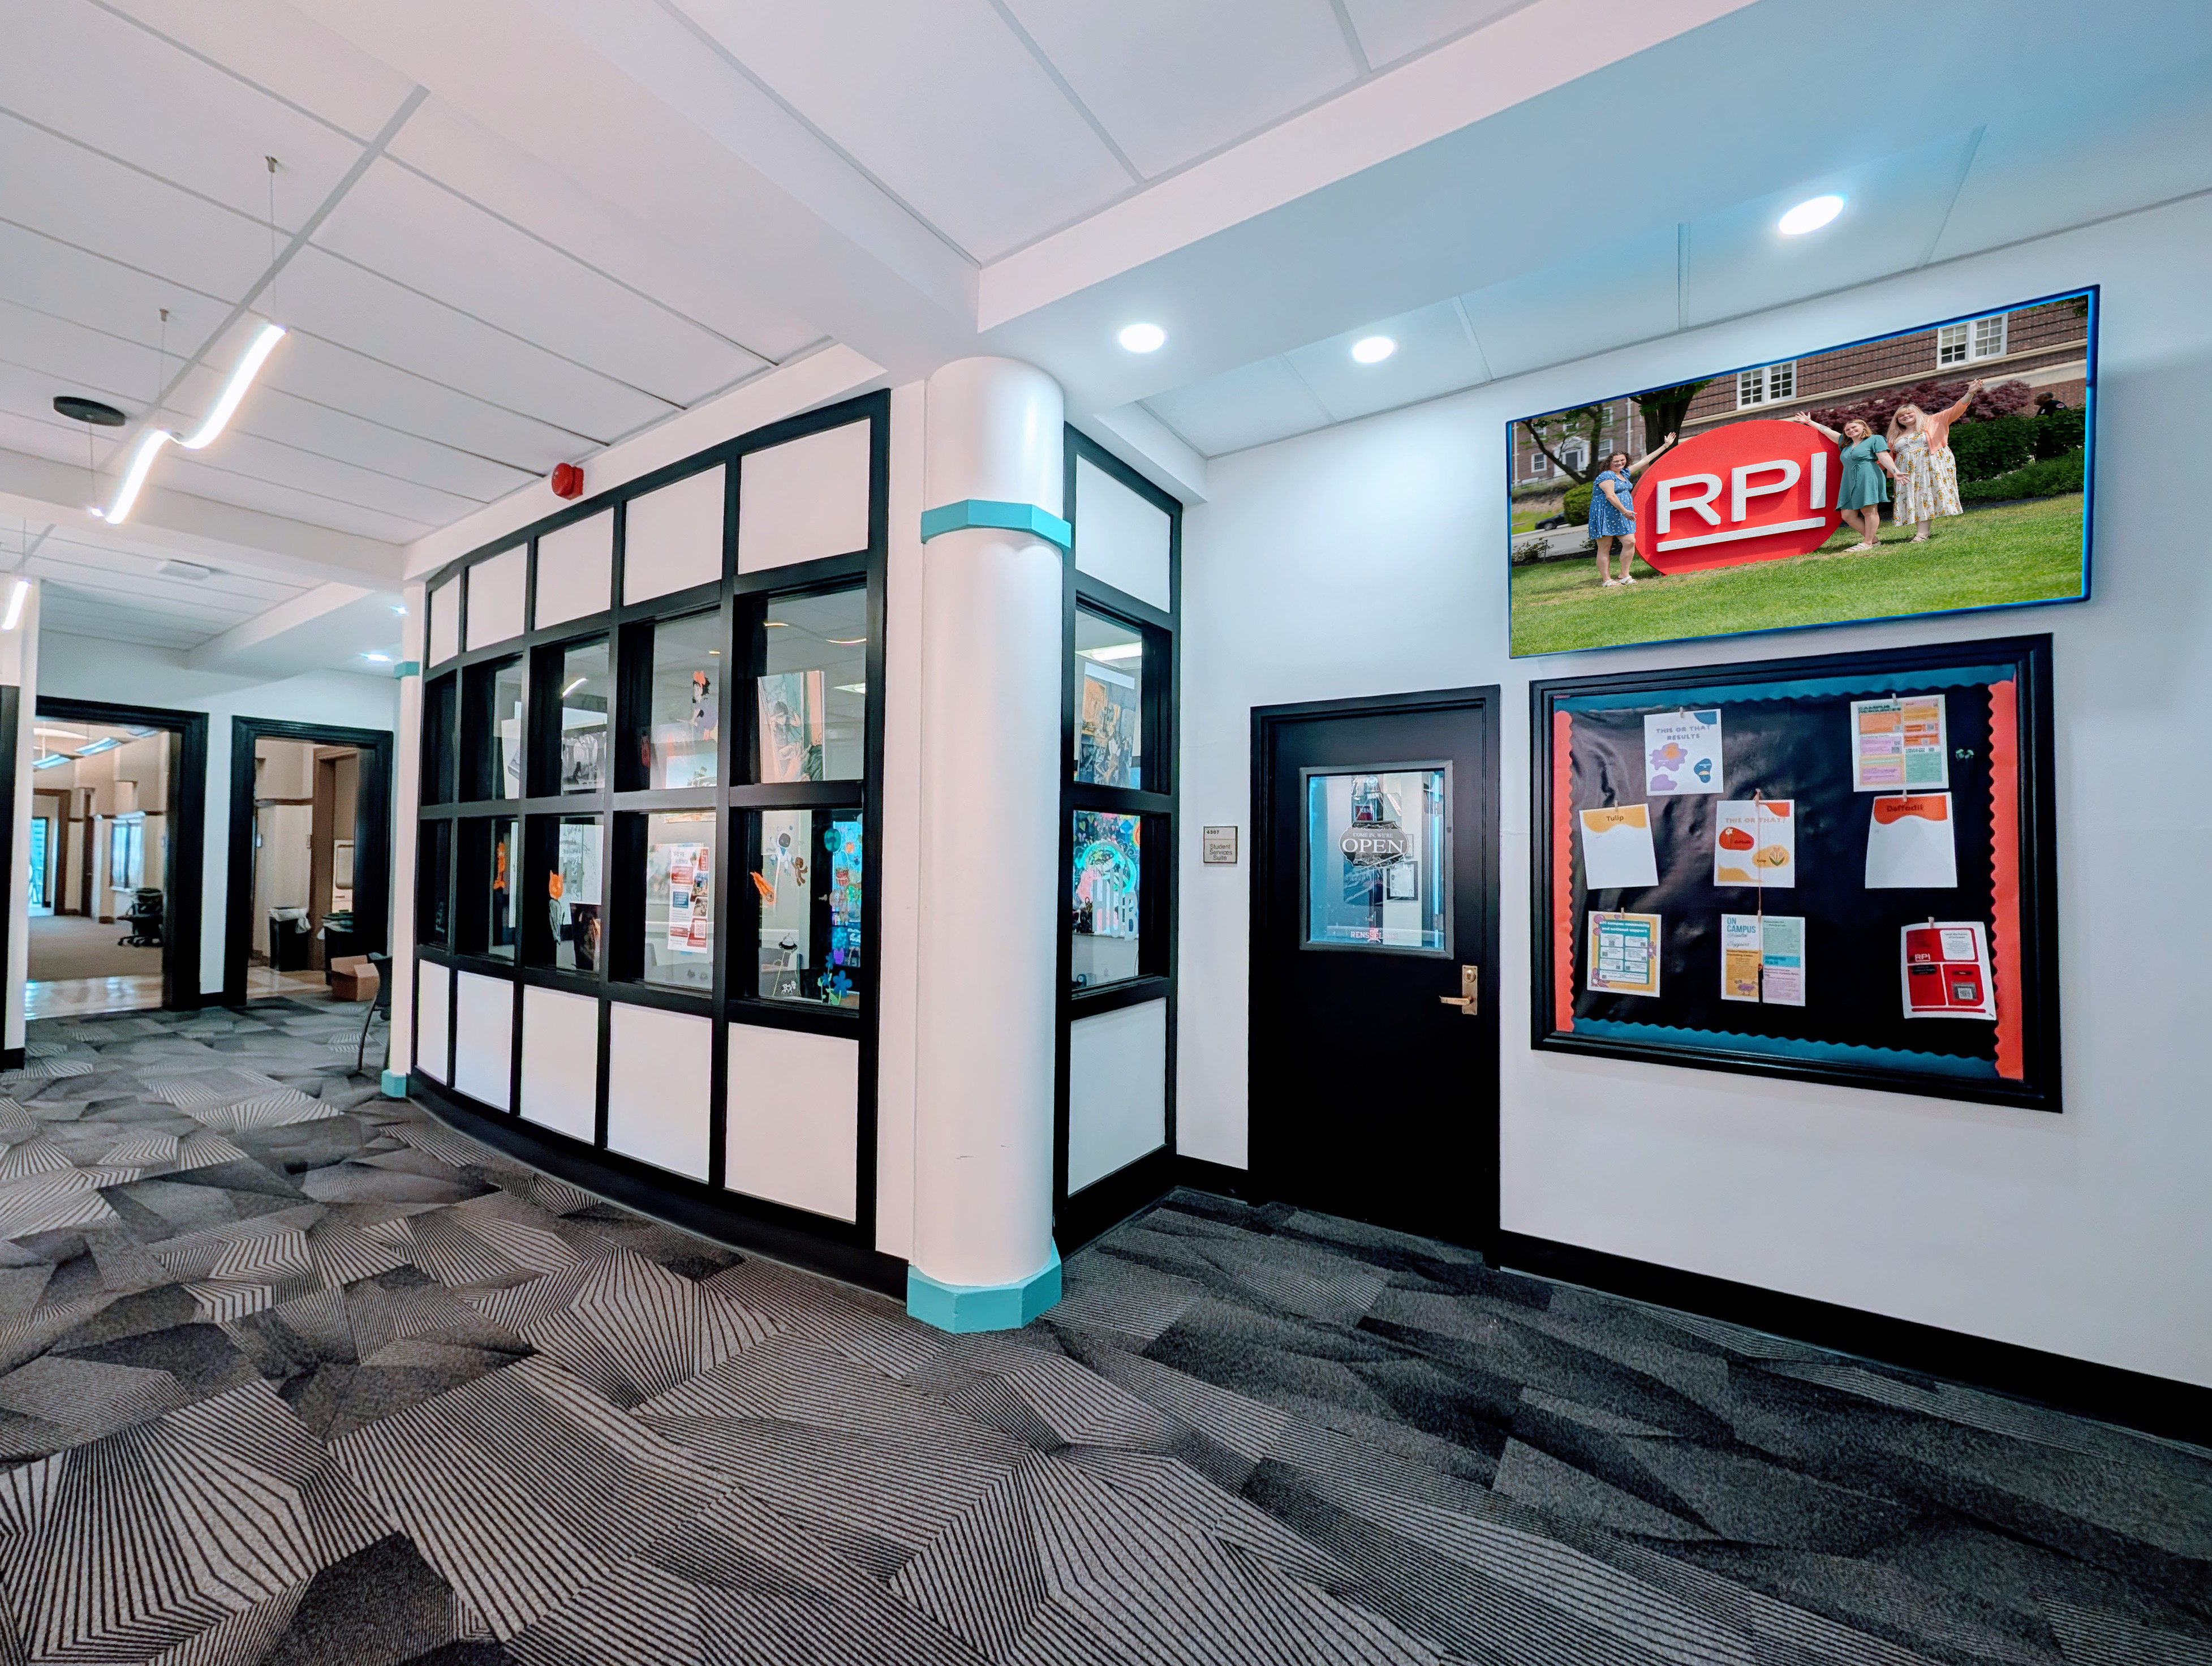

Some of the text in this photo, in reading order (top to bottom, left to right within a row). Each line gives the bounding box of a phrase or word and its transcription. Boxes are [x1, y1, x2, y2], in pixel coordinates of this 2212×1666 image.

[1655, 451, 1827, 534] RPI
[1887, 804, 1923, 812] Daffodil
[1342, 839, 1404, 854] OPEN
[1092, 868, 1139, 942] HUB
[1727, 925, 1756, 933] CAMPUS
[1350, 931, 1398, 940] RENSSEL
